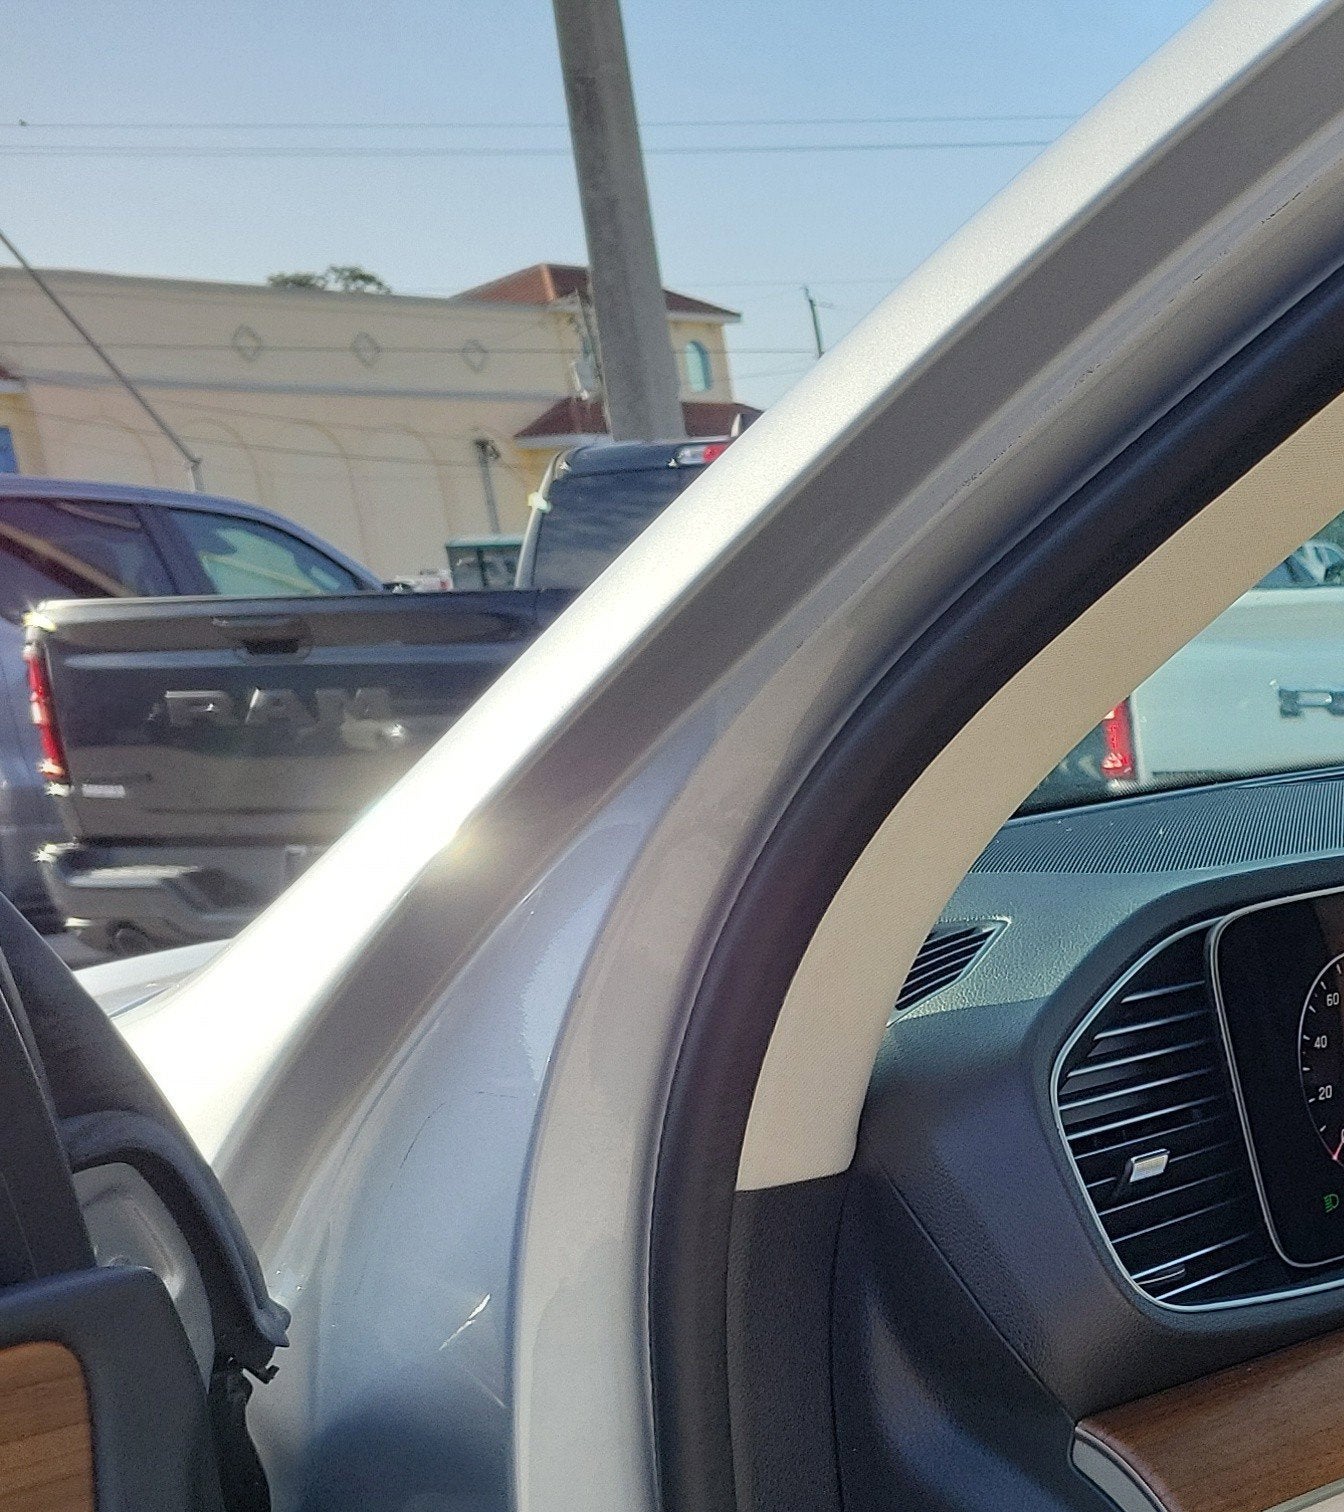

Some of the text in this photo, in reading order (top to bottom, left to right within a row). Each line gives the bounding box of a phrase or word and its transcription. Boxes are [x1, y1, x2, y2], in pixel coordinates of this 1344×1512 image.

[1326, 992, 1340, 1007] 60
[1314, 1035, 1327, 1049] 40
[1318, 1085, 1332, 1100] 20
